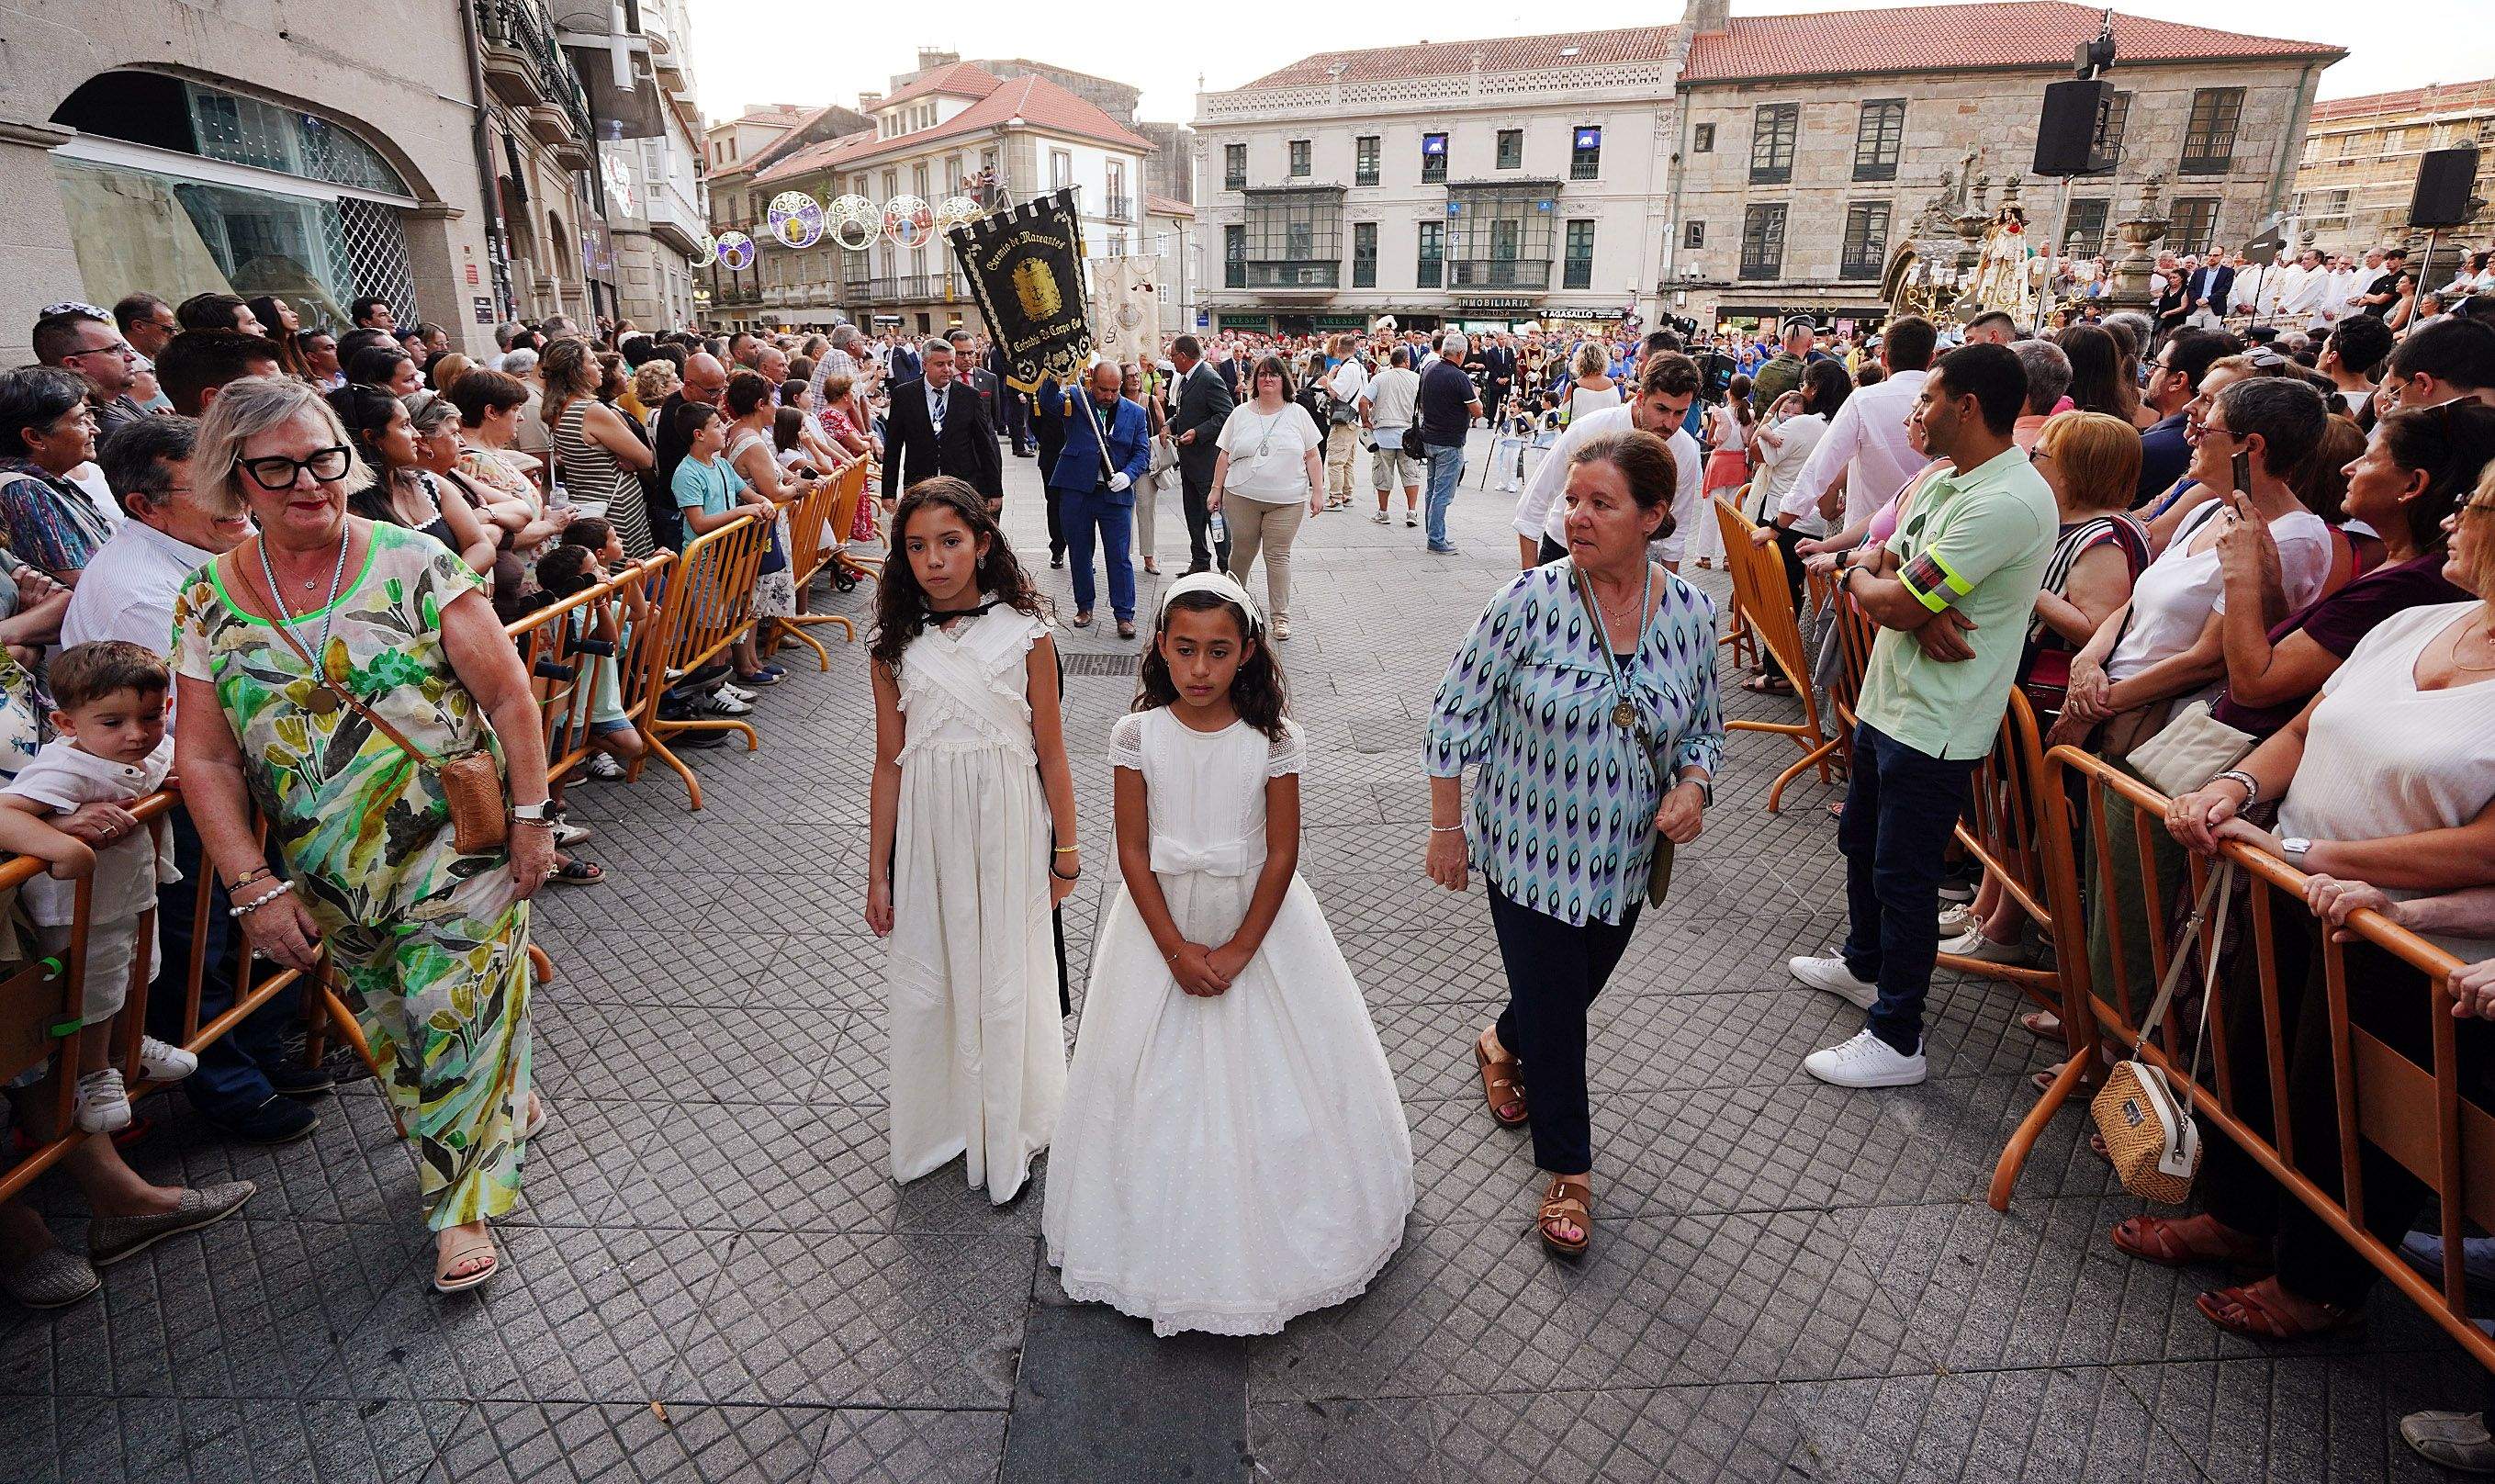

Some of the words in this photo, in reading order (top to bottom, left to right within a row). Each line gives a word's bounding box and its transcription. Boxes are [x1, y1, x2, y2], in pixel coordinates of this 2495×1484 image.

[986, 243, 1011, 271] Gremio
[1008, 237, 1020, 247] de
[1019, 230, 1065, 250] Mareantes
[1458, 298, 1530, 308] INMOBILIARIA
